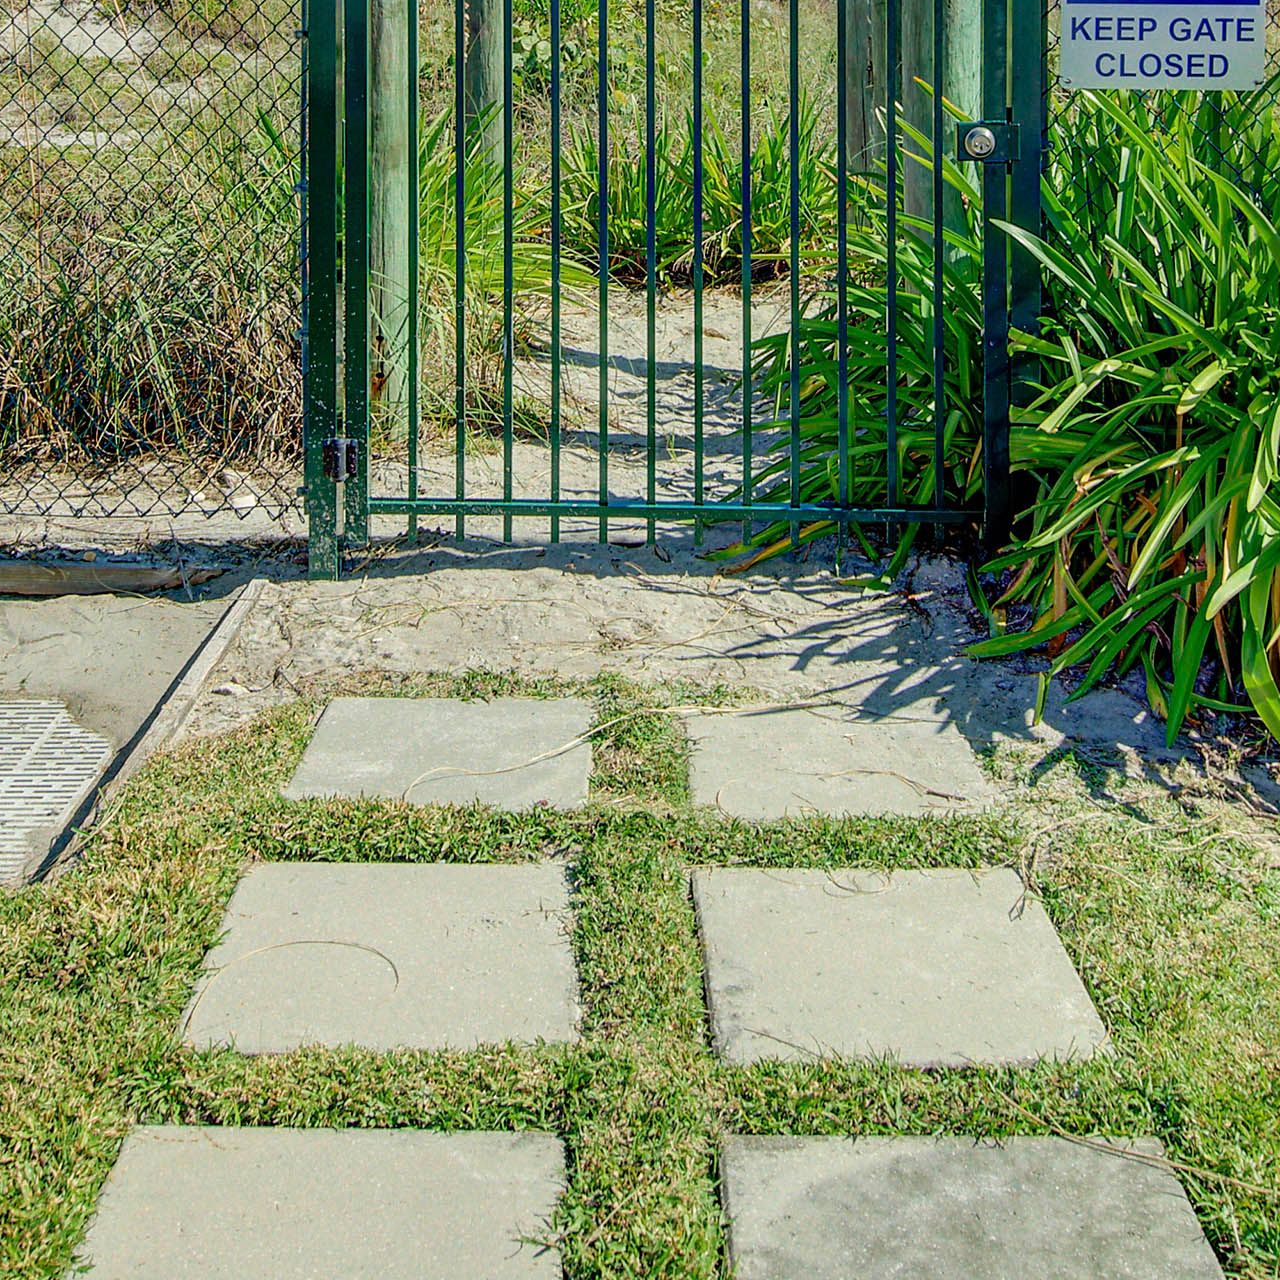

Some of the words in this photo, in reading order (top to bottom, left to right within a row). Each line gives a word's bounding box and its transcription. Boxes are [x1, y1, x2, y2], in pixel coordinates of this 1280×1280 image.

[1071, 17, 1158, 42] KEEP
[1168, 17, 1255, 43] GATE
[1095, 53, 1230, 78] CLOSED
